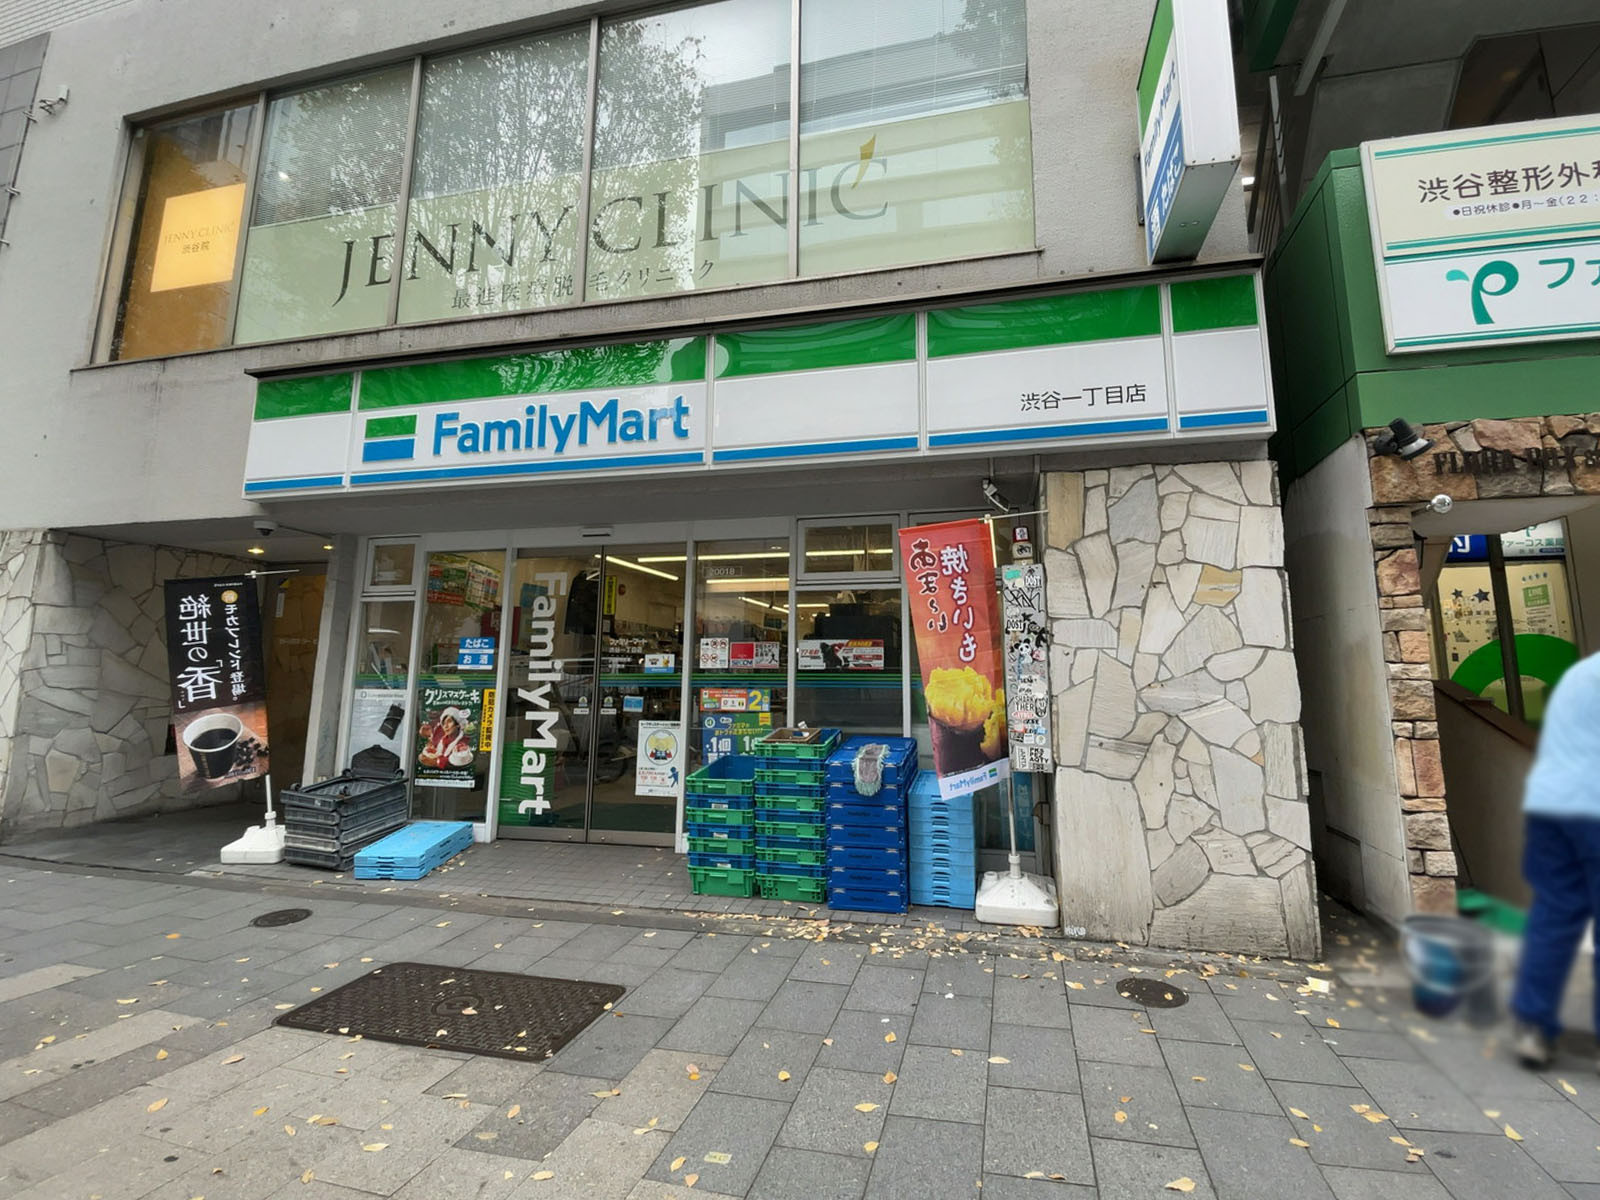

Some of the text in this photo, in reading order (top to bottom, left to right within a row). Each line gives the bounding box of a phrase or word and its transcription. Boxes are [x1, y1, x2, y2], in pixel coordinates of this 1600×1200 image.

[164, 228, 196, 245] JENNY
[332, 155, 889, 307] JENNY CLINIC
[1020, 384, 1147, 412] 渋谷一丁目店
[432, 395, 691, 457] FamilyMart
[464, 638, 490, 649] たばこ
[424, 688, 481, 705] クリスマスケーキ
[517, 571, 568, 816] FamilyMart
